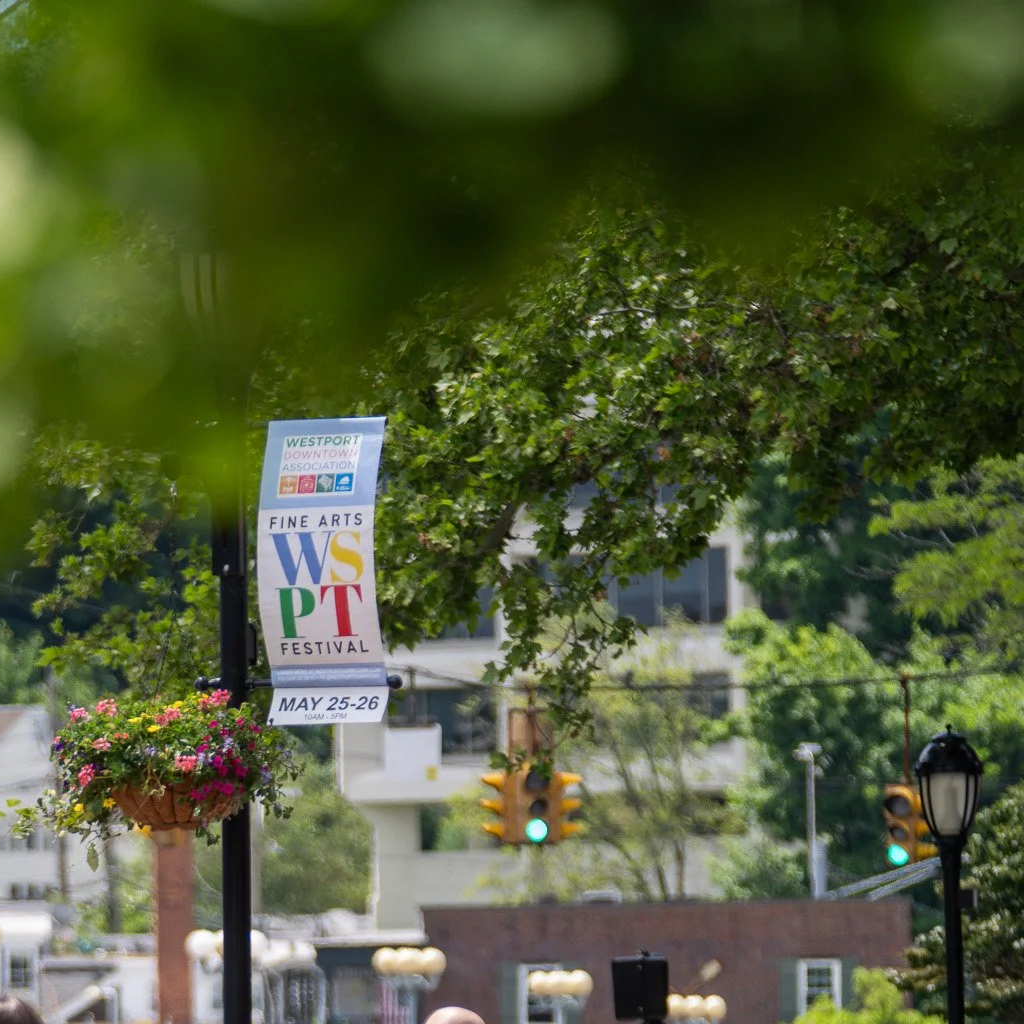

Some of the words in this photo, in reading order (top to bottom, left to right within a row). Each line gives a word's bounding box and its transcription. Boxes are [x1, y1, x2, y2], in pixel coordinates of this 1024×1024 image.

[286, 434, 361, 448] WESTPORT
[284, 448, 358, 460] DOWNTOWN
[282, 460, 356, 472] ASSOCIATION
[269, 515, 309, 529] FINE
[318, 512, 363, 527] ARTS
[269, 530, 364, 586] WS
[276, 584, 363, 638] PT
[280, 640, 369, 655] FESTIVAL
[278, 696, 323, 712] MAY
[326, 695, 380, 711] 25-26
[330, 712, 348, 720] 5PM
